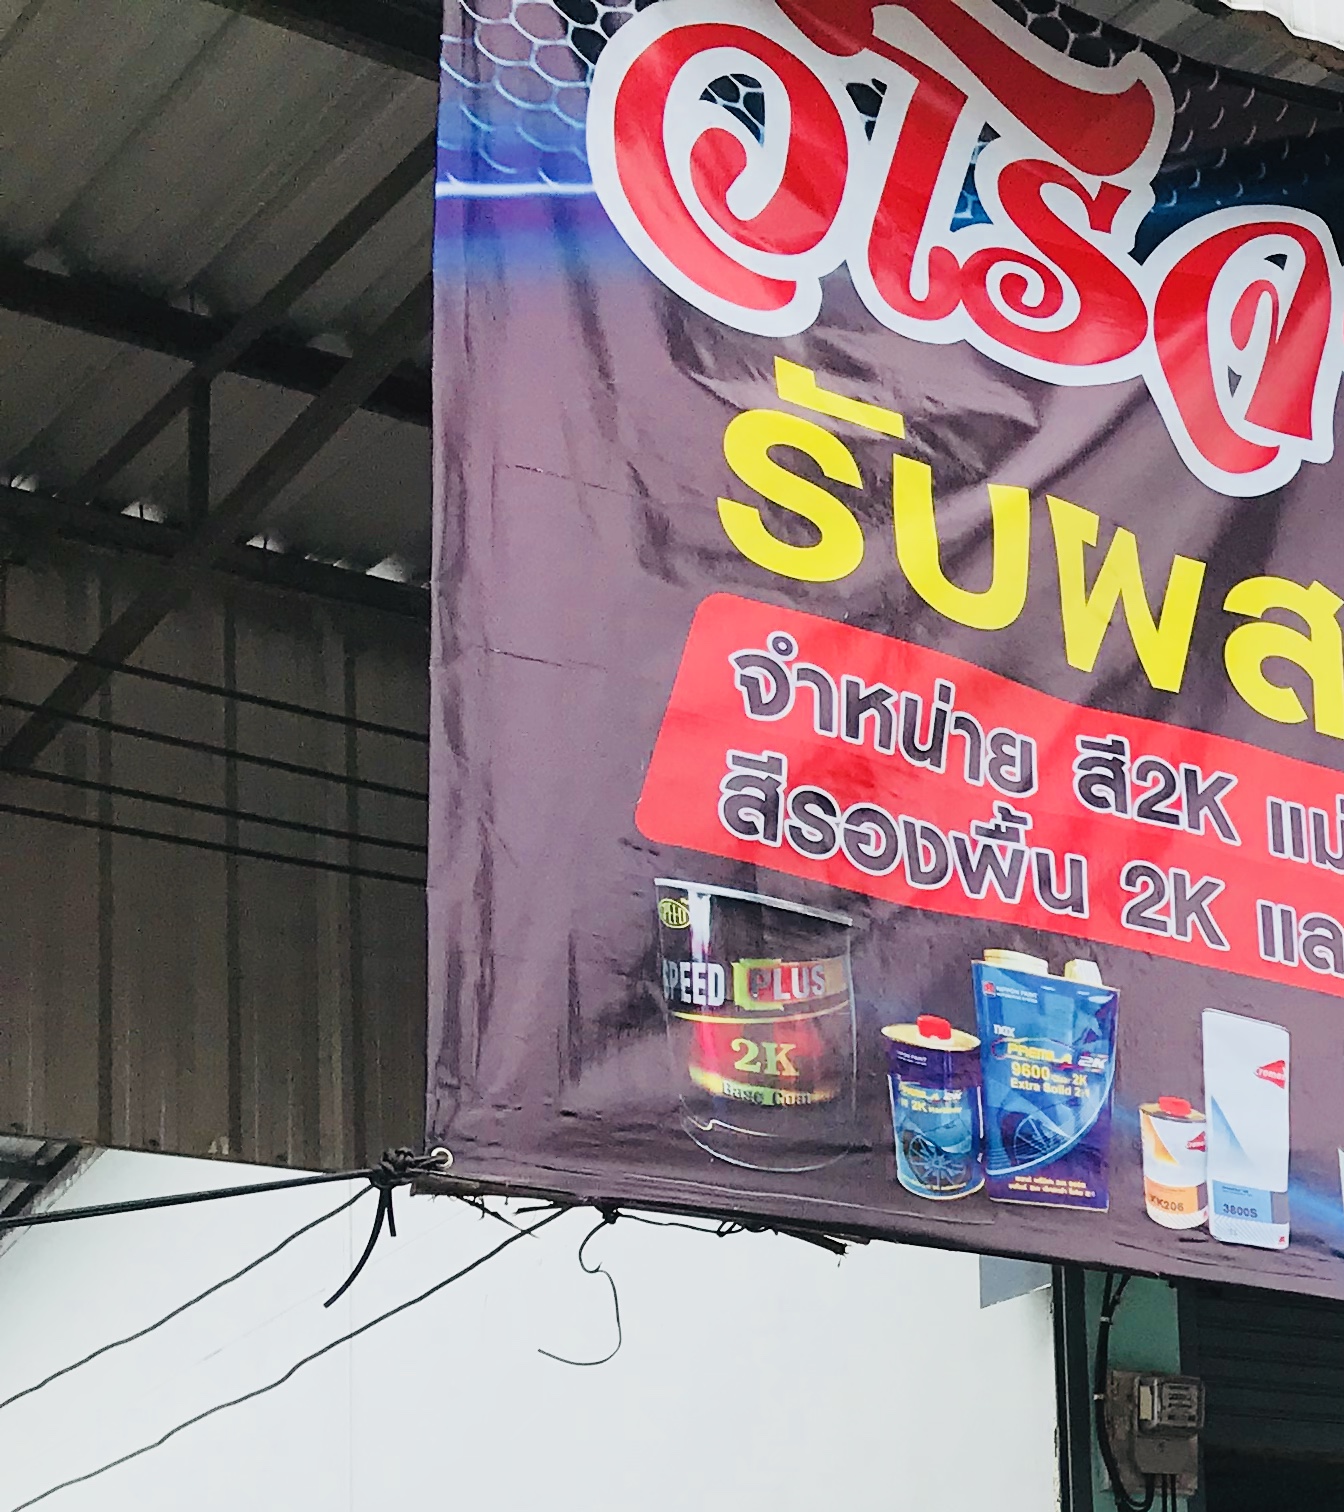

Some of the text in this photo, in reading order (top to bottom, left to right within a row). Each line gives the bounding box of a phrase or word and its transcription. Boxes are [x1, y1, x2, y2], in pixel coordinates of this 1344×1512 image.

[730, 629, 1038, 797] จำหน่าย
[1071, 732, 1242, 847] สี2K
[718, 748, 1091, 921] สีรองพื้น
[1120, 861, 1230, 953] 2K
[750, 965, 826, 1000] PLUS
[731, 1037, 799, 1077] 2K
[1011, 1062, 1050, 1081] 9600
[1010, 1077, 1042, 1092] Extra
[1222, 1203, 1259, 1219] 3800S
